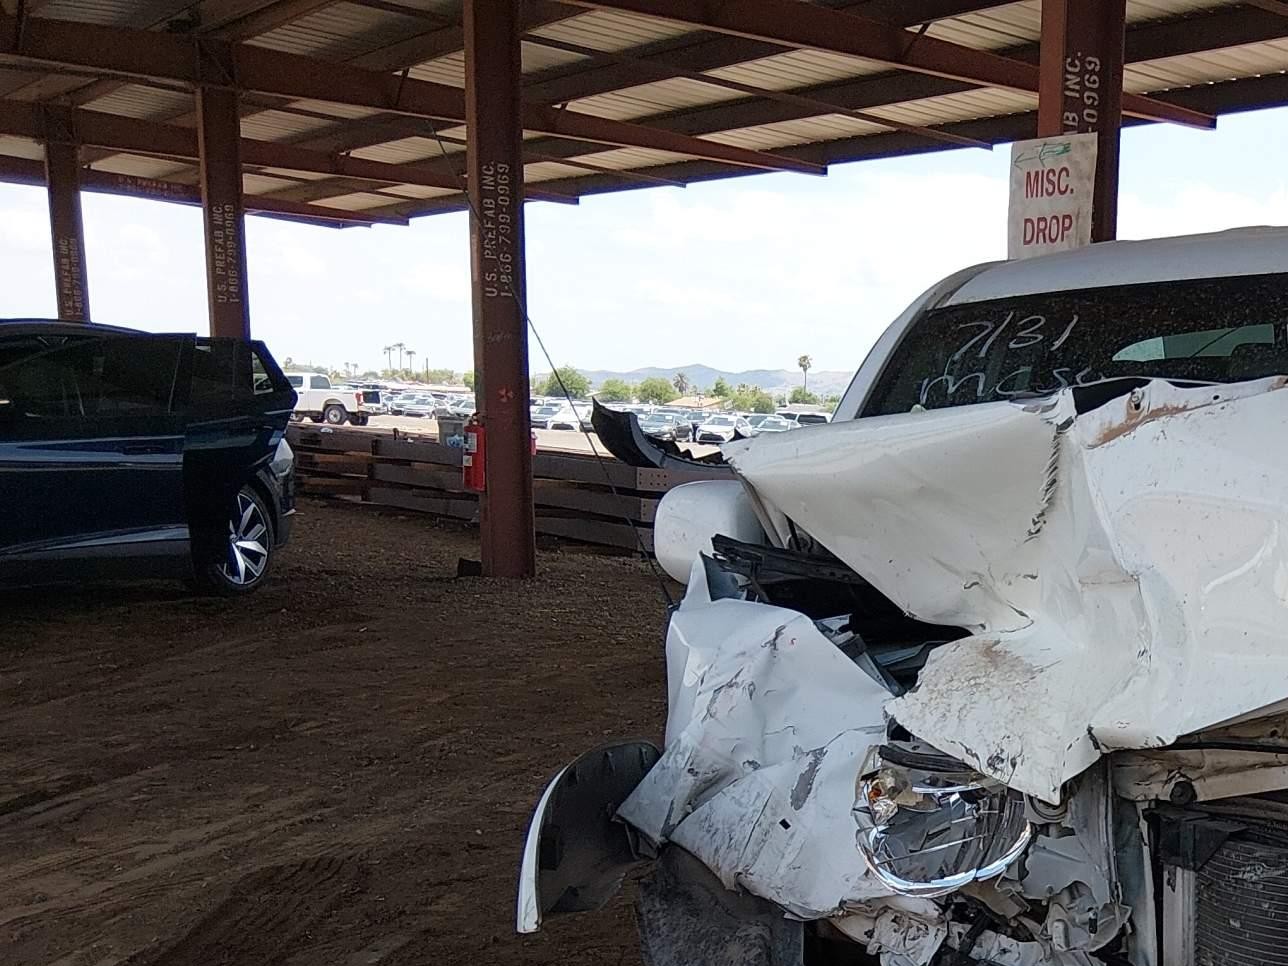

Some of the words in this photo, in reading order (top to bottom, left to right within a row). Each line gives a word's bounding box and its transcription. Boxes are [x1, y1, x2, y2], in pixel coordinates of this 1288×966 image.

[1064, 51, 1082, 98] INC.
[482, 161, 495, 190] INC.
[1025, 166, 1075, 199] MISC.
[483, 199, 497, 259] PREFAB
[497, 162, 512, 297] 1-866-799-0969
[1023, 214, 1073, 246] DROP
[214, 230, 226, 275] PREFAB
[485, 267, 498, 297] U.S.
[959, 311, 1079, 360] 7/31
